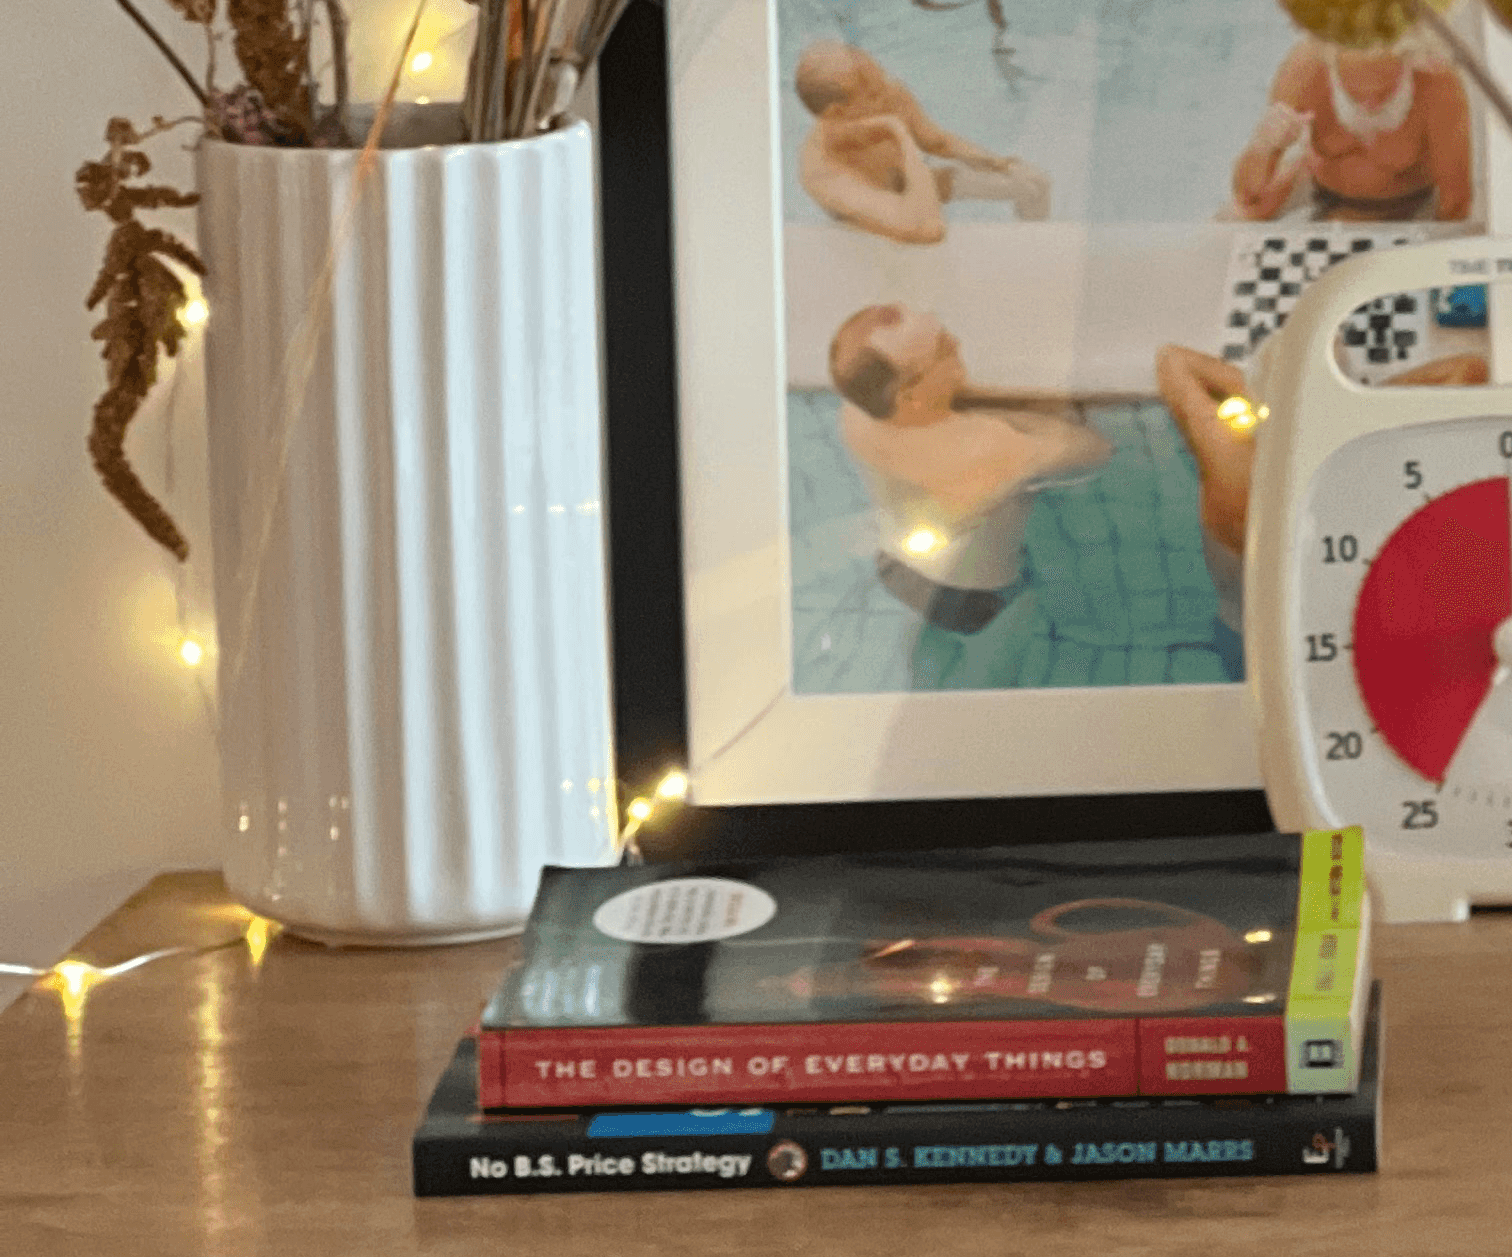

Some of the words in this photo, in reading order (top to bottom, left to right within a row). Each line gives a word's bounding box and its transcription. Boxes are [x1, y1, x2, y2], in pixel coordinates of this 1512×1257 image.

[1405, 461, 1423, 489] 5
[1322, 535, 1358, 563] 10
[1306, 634, 1338, 663] 15
[1326, 733, 1362, 760] 20
[1402, 800, 1438, 830] 25
[535, 1059, 597, 1079] THE
[613, 1057, 733, 1078] DESIGN
[747, 1056, 789, 1075] OF
[805, 1052, 970, 1074] EVERYDAY
[984, 1050, 1107, 1072] THINGS
[470, 1156, 508, 1179] No
[515, 1155, 562, 1177] B.S.
[568, 1153, 634, 1176] Price
[642, 1151, 752, 1177] Strategy
[821, 1147, 878, 1170] DAN
[914, 1144, 1038, 1168] KENNEDY
[1071, 1143, 1157, 1165] JASON
